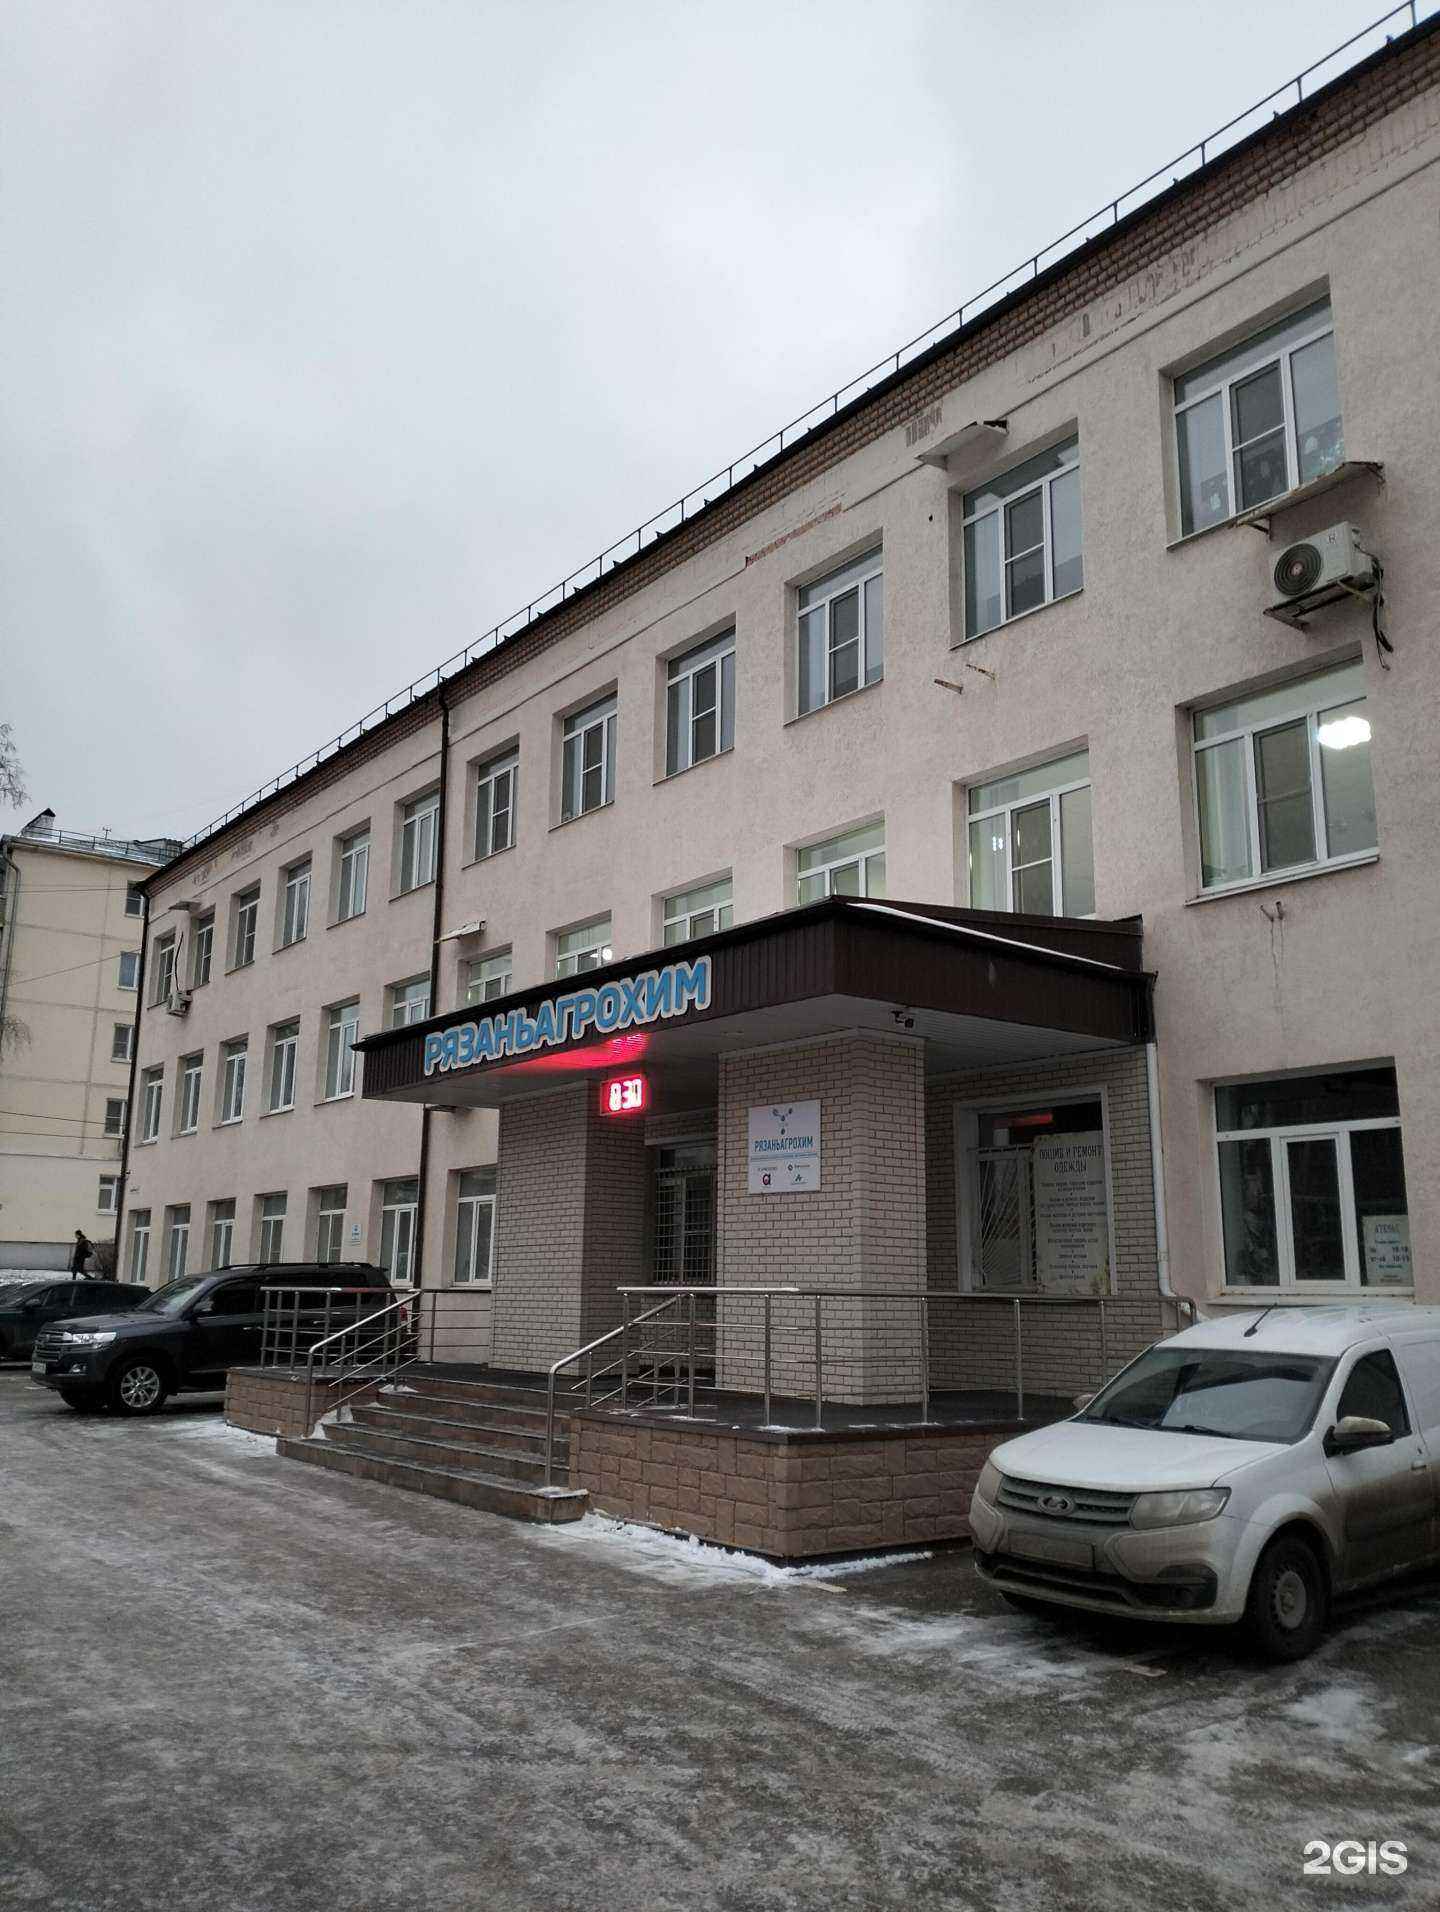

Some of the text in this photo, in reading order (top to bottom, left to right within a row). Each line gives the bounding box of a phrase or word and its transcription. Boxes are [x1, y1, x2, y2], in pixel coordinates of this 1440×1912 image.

[424, 955, 711, 1076] РЯЗАНЬАГРОХИМ
[754, 1136, 813, 1152] РЯЗАНЬАГРОХИМ
[1072, 1144, 1102, 1158] РЕМОНТ
[1055, 1159, 1087, 1174] ОДЕЖДЫ
